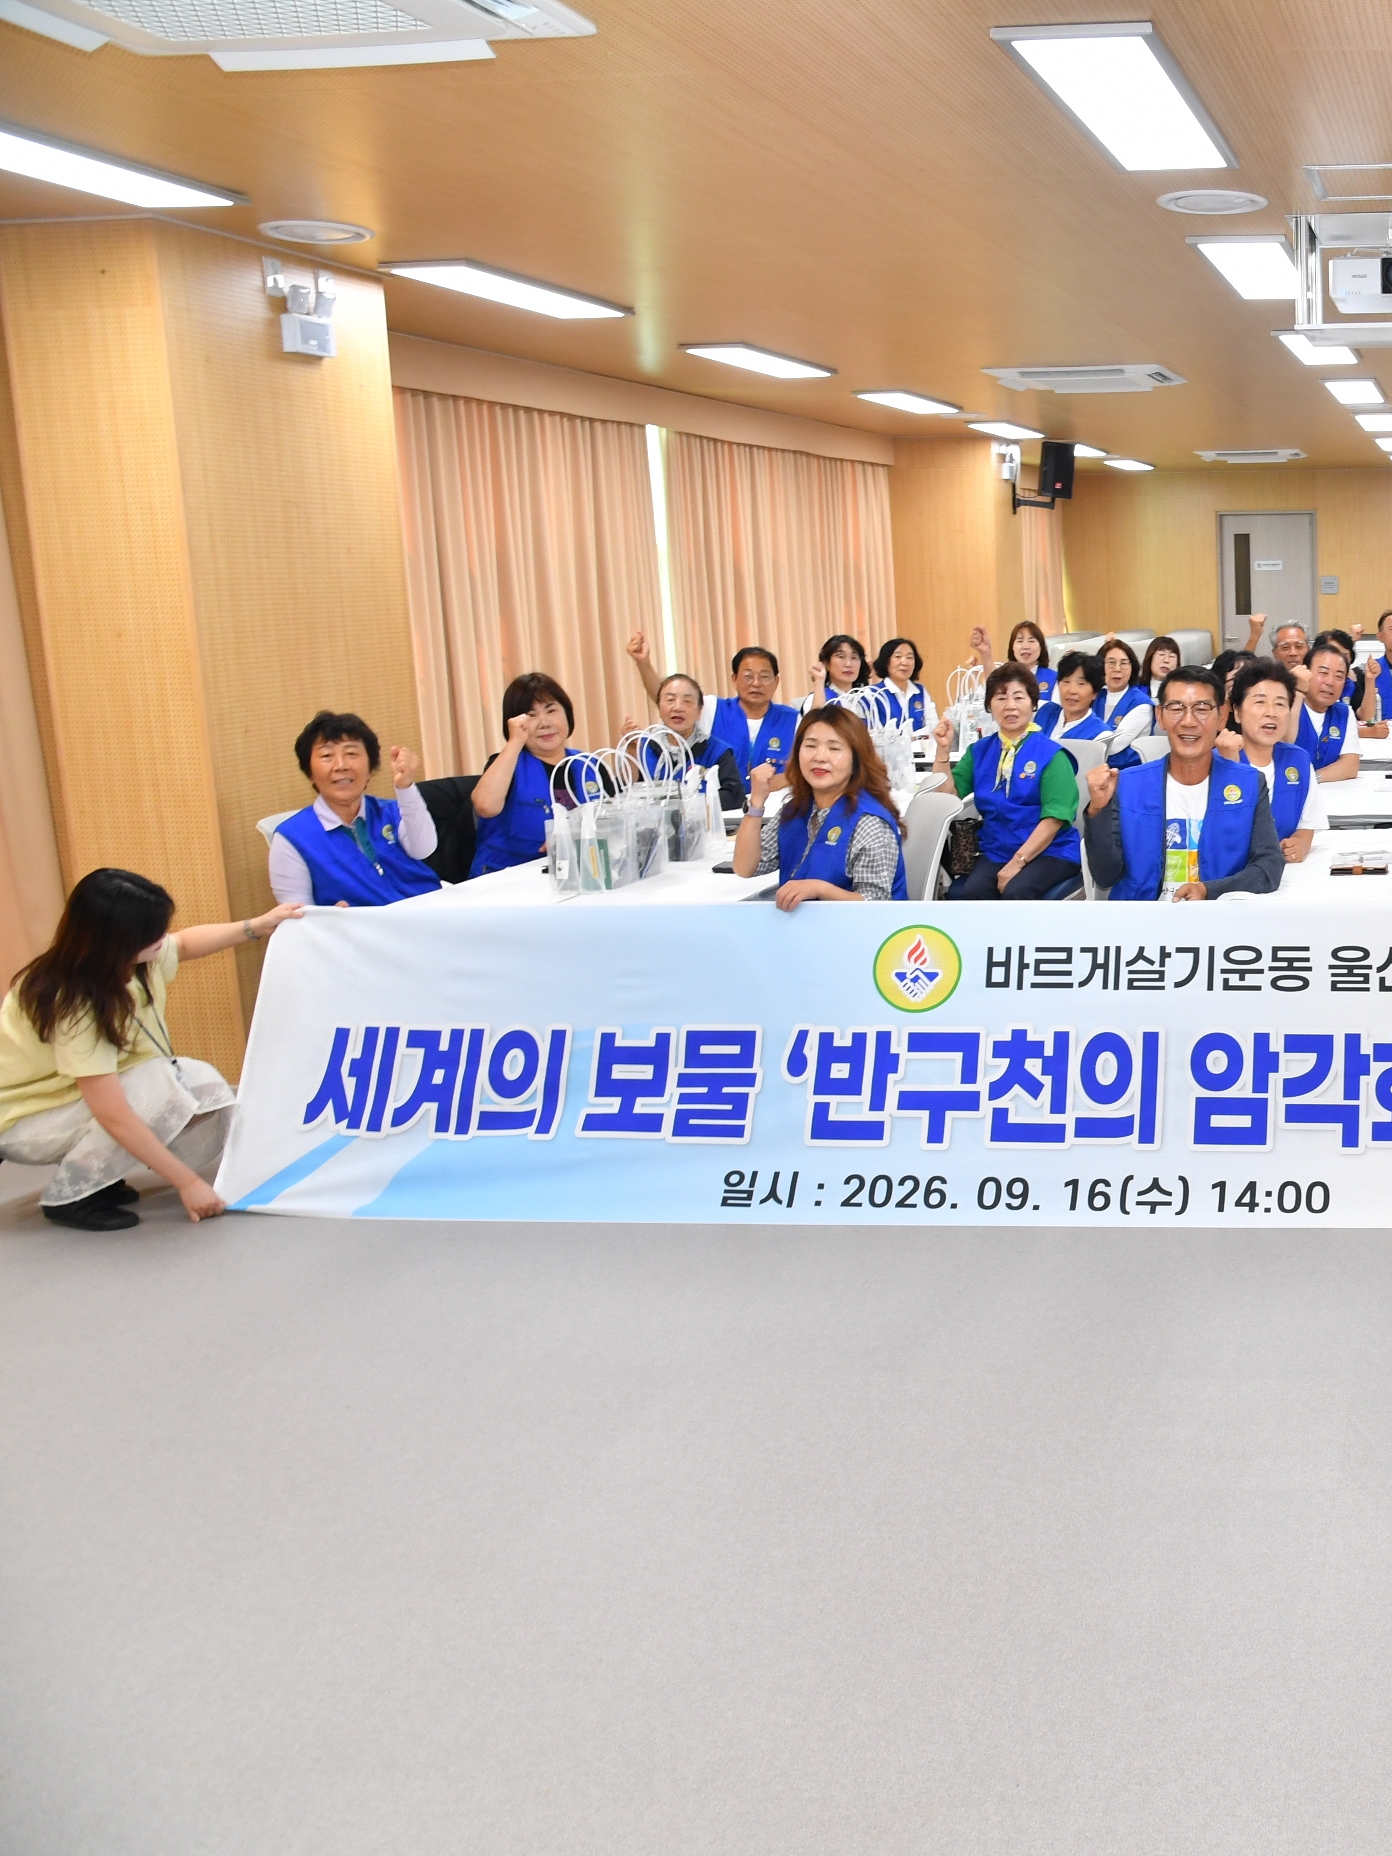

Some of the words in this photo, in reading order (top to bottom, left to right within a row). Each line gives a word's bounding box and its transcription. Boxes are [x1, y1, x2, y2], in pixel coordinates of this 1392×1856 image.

[987, 945, 1314, 994] 바르게살기운동
[303, 1026, 568, 1137] 세계의
[582, 1030, 759, 1140] 보물
[720, 1170, 800, 1209] 일시
[841, 1175, 959, 1210] 2026.
[977, 1177, 1041, 1212] 09.
[1065, 1175, 1191, 1217] 16(수)
[1211, 1181, 1331, 1215] 14:00
